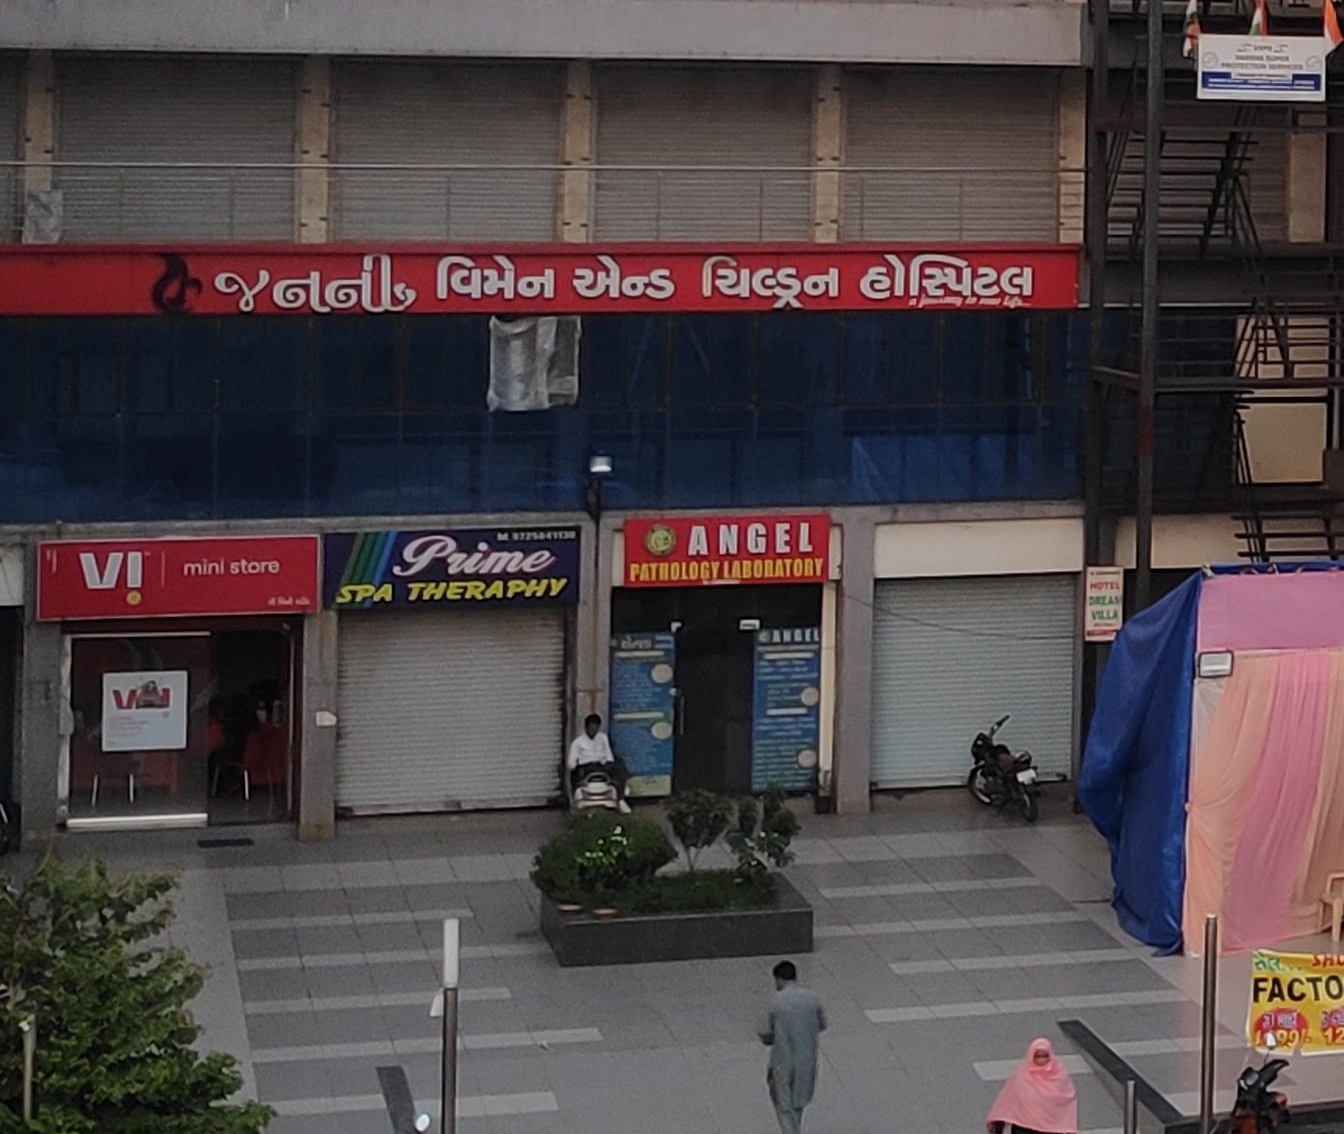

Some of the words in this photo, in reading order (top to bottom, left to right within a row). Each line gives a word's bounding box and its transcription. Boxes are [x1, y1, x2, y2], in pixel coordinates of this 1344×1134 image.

[437, 255, 555, 300] વિમેન
[572, 255, 676, 300] એન્ડ
[702, 255, 839, 308] ચિલ્ડ્રન
[859, 254, 1033, 299] હોસ્પિટલ
[688, 522, 813, 556] ANGEL
[393, 535, 557, 577] Prime
[183, 558, 225, 576] mini
[230, 558, 280, 575] store
[629, 561, 720, 582] PATHOLOGY
[722, 557, 824, 579] LABORATORY
[336, 583, 393, 604] SPA
[407, 578, 568, 601] THERAPHY
[1090, 581, 1120, 590] HOTEL
[1091, 610, 1118, 620] VILLA
[772, 629, 820, 643] ANGEL
[1254, 1029, 1314, 1047] 199/-
